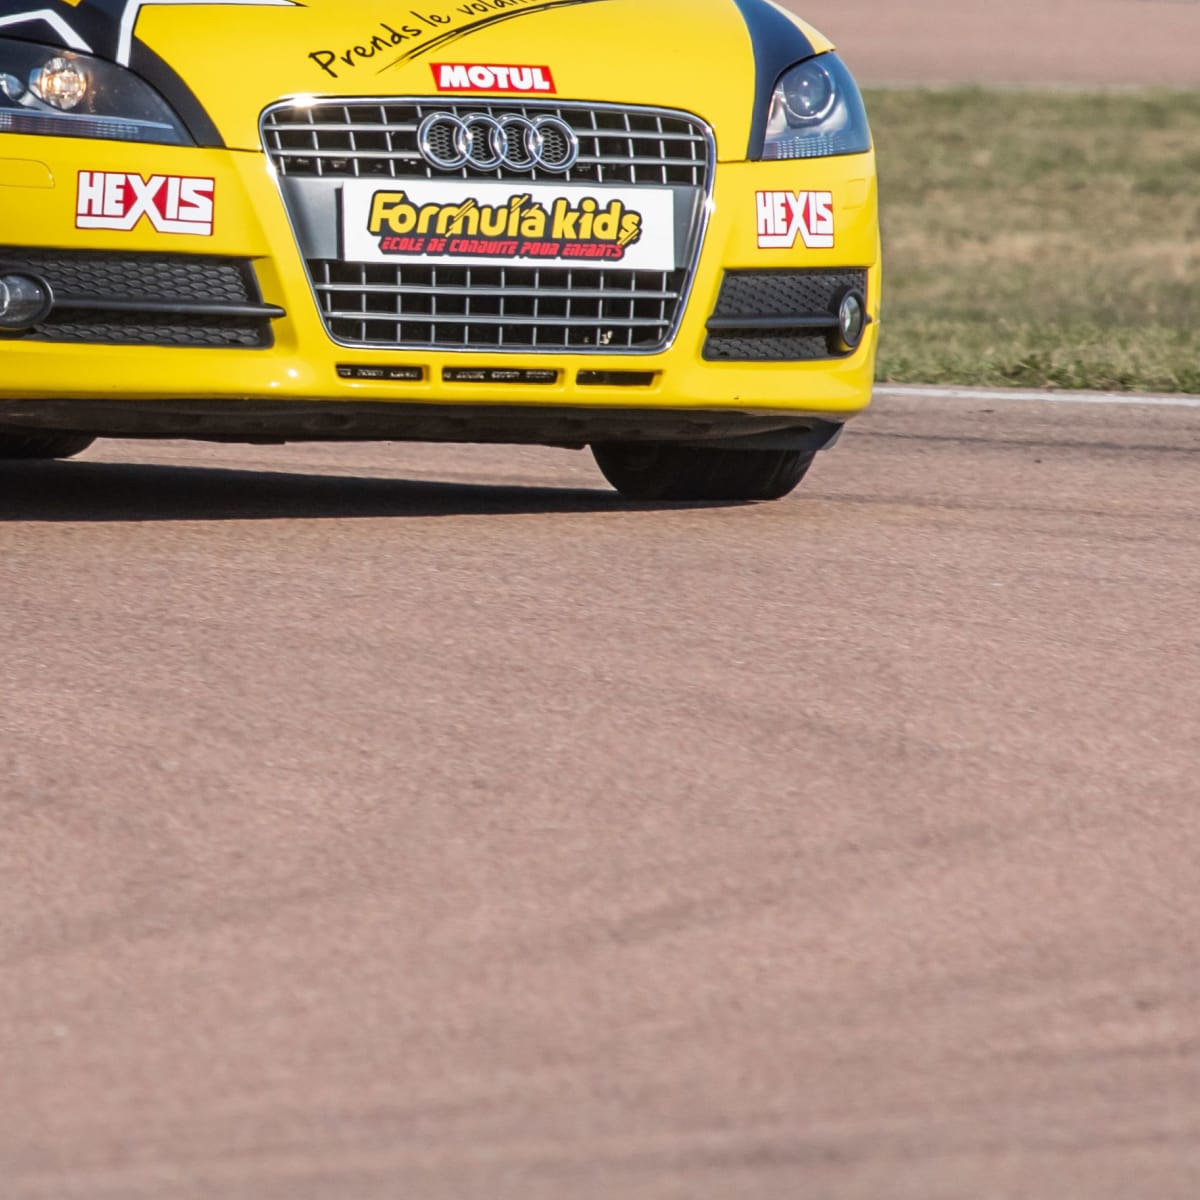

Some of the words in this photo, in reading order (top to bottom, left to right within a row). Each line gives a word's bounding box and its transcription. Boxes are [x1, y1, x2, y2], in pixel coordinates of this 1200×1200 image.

[308, 22, 422, 79] Prends
[410, 10, 451, 27] le
[438, 65, 550, 92] MOTUL
[76, 170, 215, 236] HEXIS
[368, 191, 546, 239] Formula
[552, 198, 642, 246] kids
[755, 190, 834, 249] HEXIS
[381, 237, 423, 252] ECOLE
[427, 238, 445, 253] DE
[449, 238, 517, 256] CONDUITE
[520, 241, 560, 256] POUR
